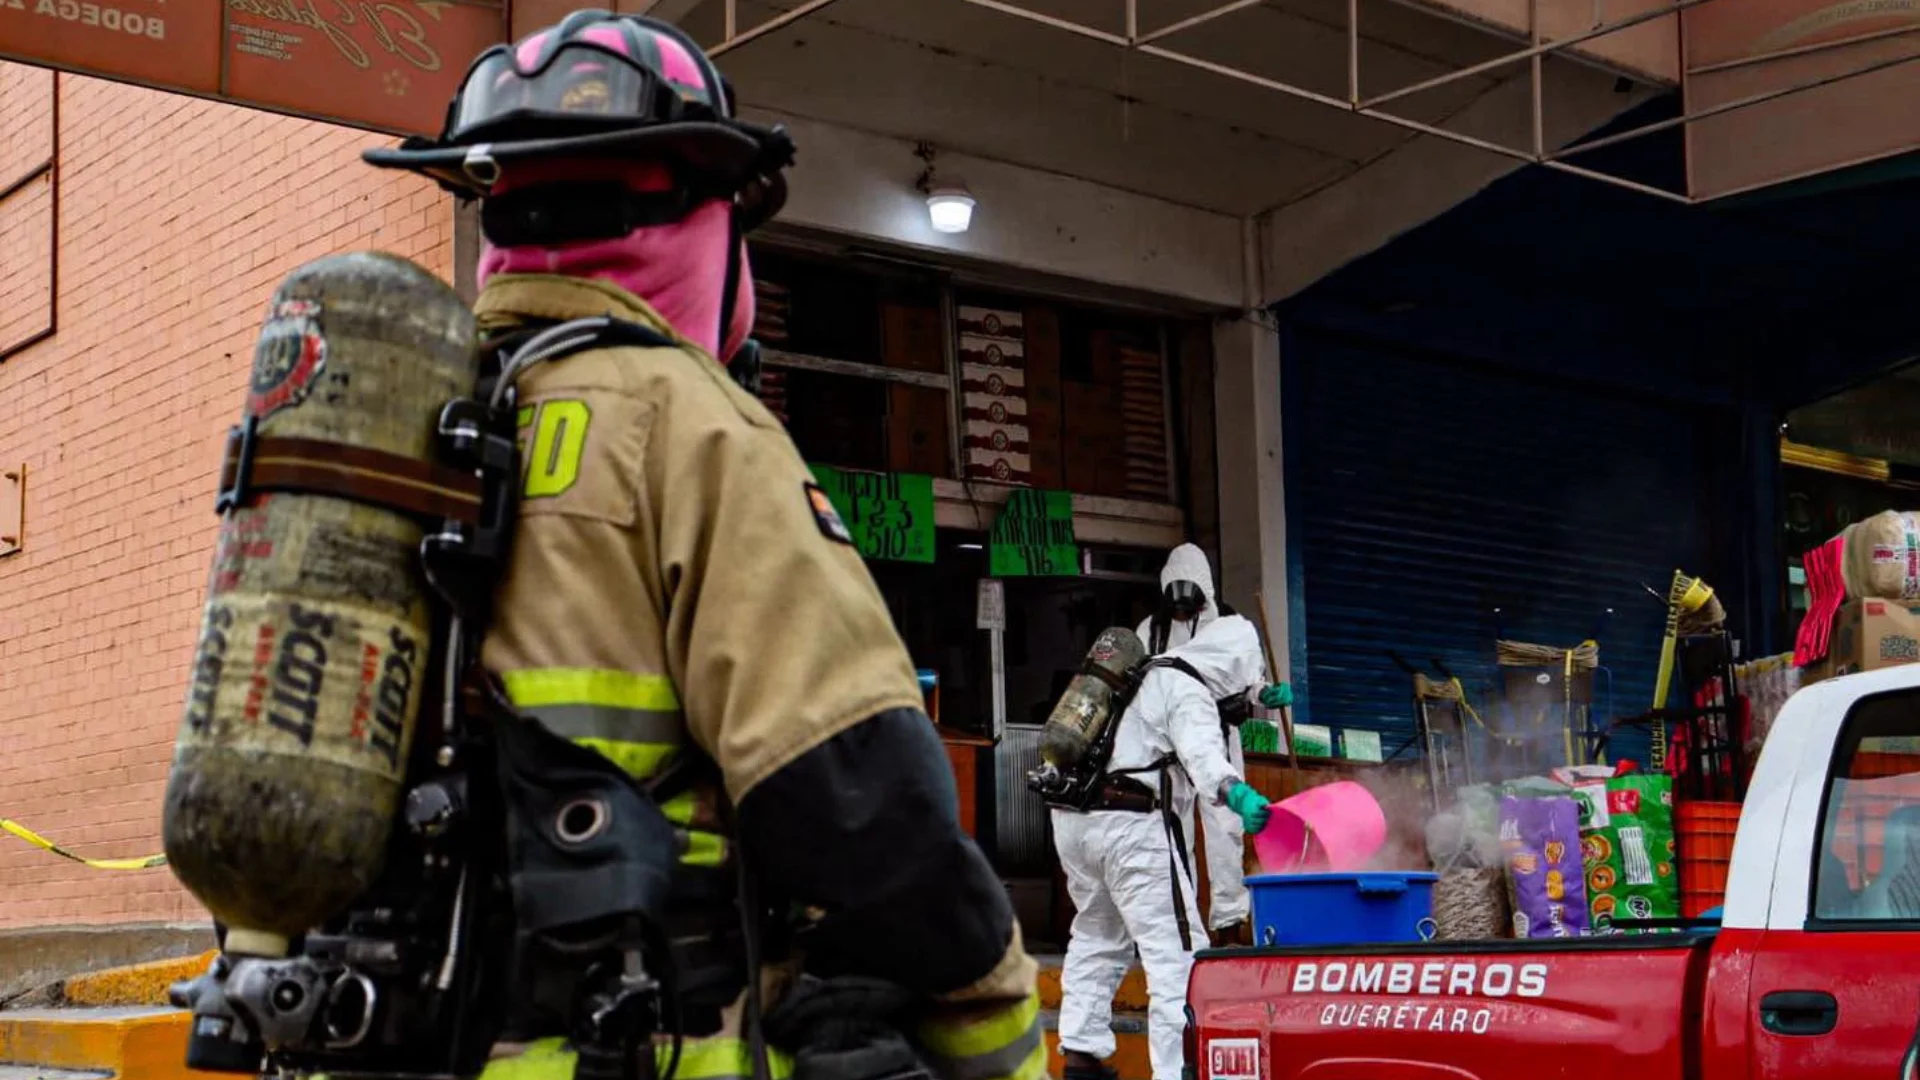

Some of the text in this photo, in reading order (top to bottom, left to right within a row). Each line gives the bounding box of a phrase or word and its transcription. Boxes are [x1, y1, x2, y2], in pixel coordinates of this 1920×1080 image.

[266, 602, 337, 750] SCOTT
[371, 625, 417, 774] SCOTT
[1292, 962, 1548, 997] BOMBEROS
[1214, 1049, 1252, 1072] 911
